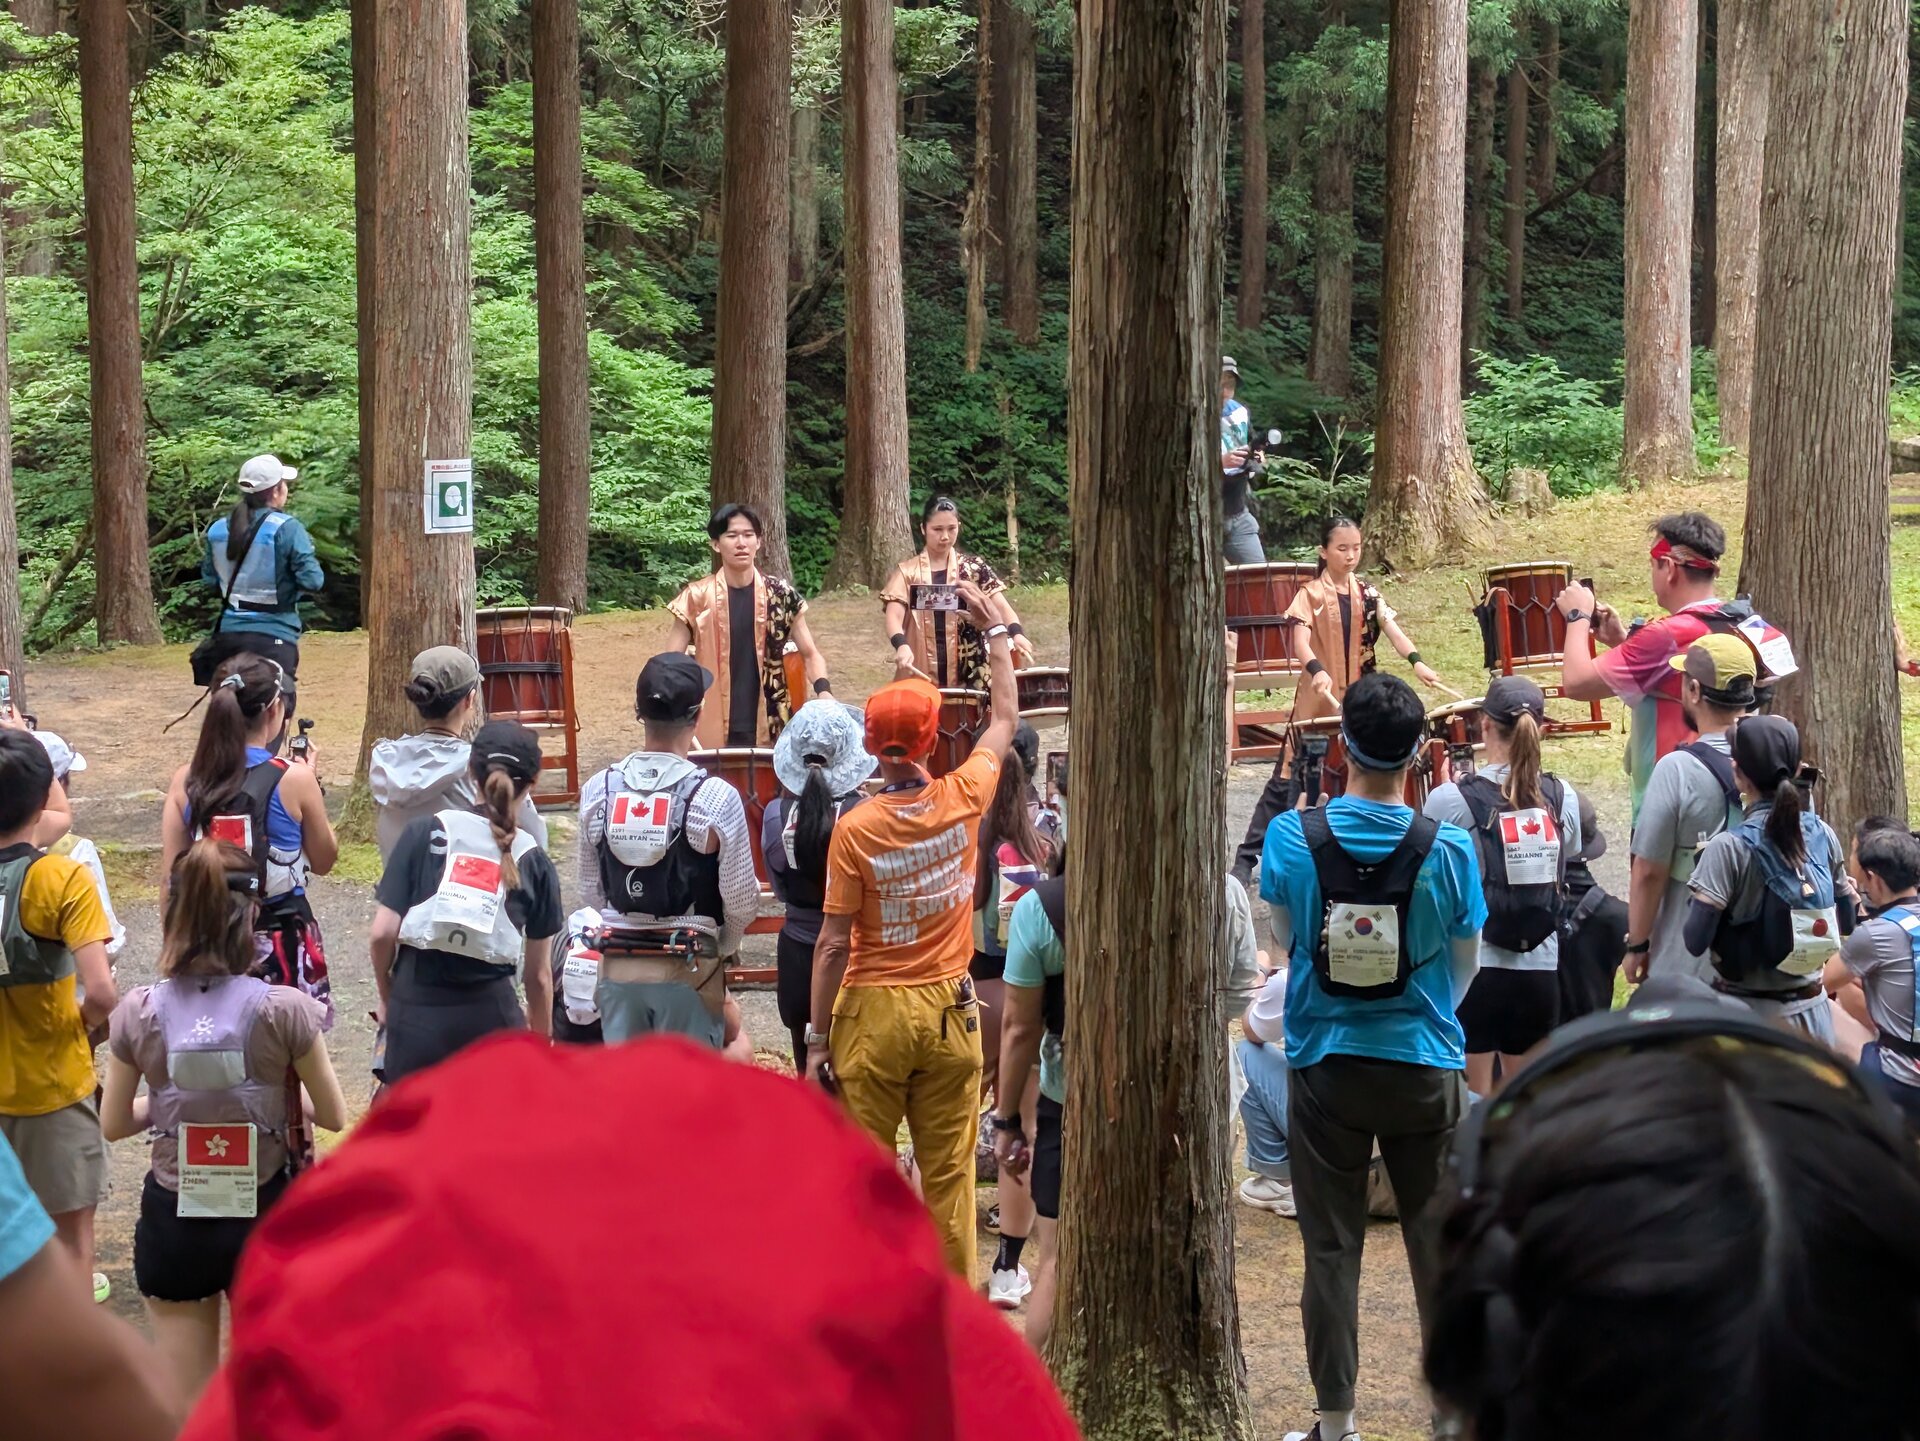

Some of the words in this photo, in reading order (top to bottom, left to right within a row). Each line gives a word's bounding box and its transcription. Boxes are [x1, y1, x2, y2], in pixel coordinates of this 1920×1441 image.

[871, 822, 969, 882] WHEREVER
[876, 875, 917, 897] YOU
[919, 854, 963, 895] RACE
[880, 898, 913, 924] WE
[881, 922, 919, 946] YOU
